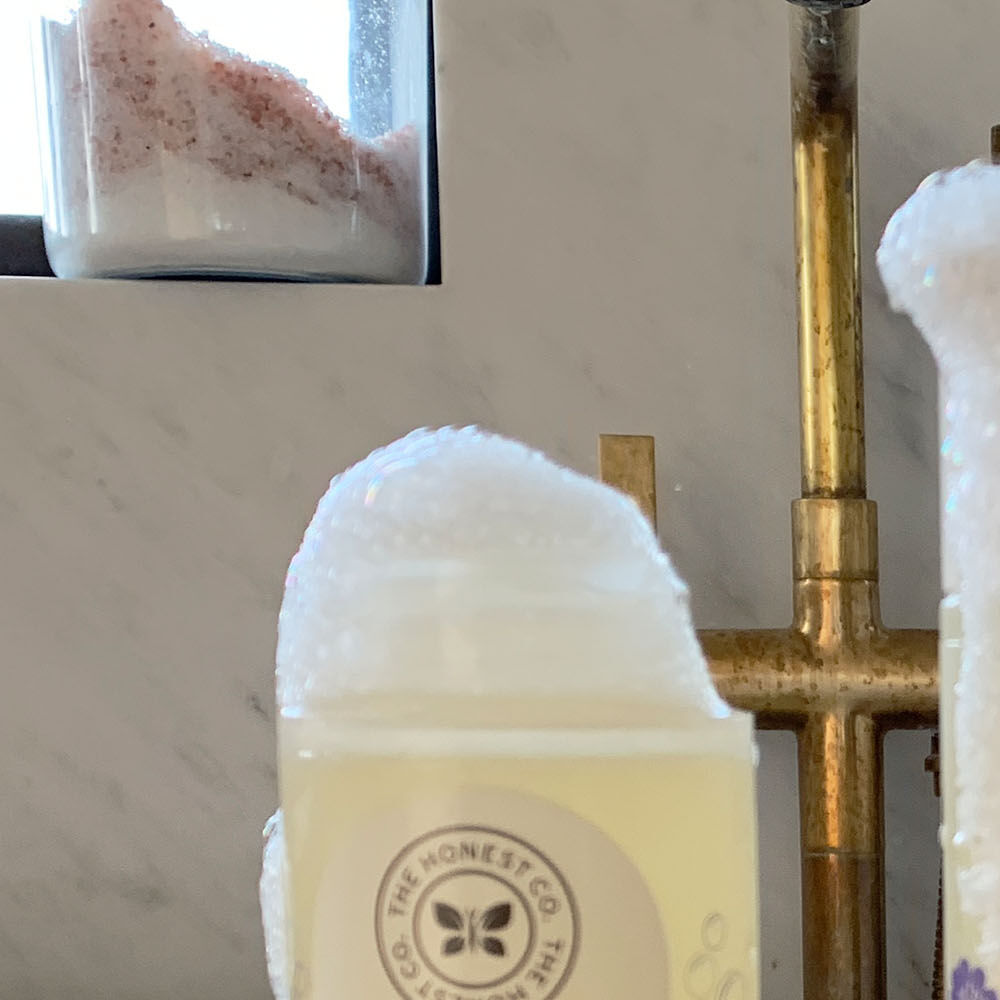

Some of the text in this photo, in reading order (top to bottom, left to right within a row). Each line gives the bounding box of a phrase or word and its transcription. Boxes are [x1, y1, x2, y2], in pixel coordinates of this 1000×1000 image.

[387, 865, 419, 917] THE
[418, 841, 532, 877] HONEST
[526, 939, 563, 986] THE
